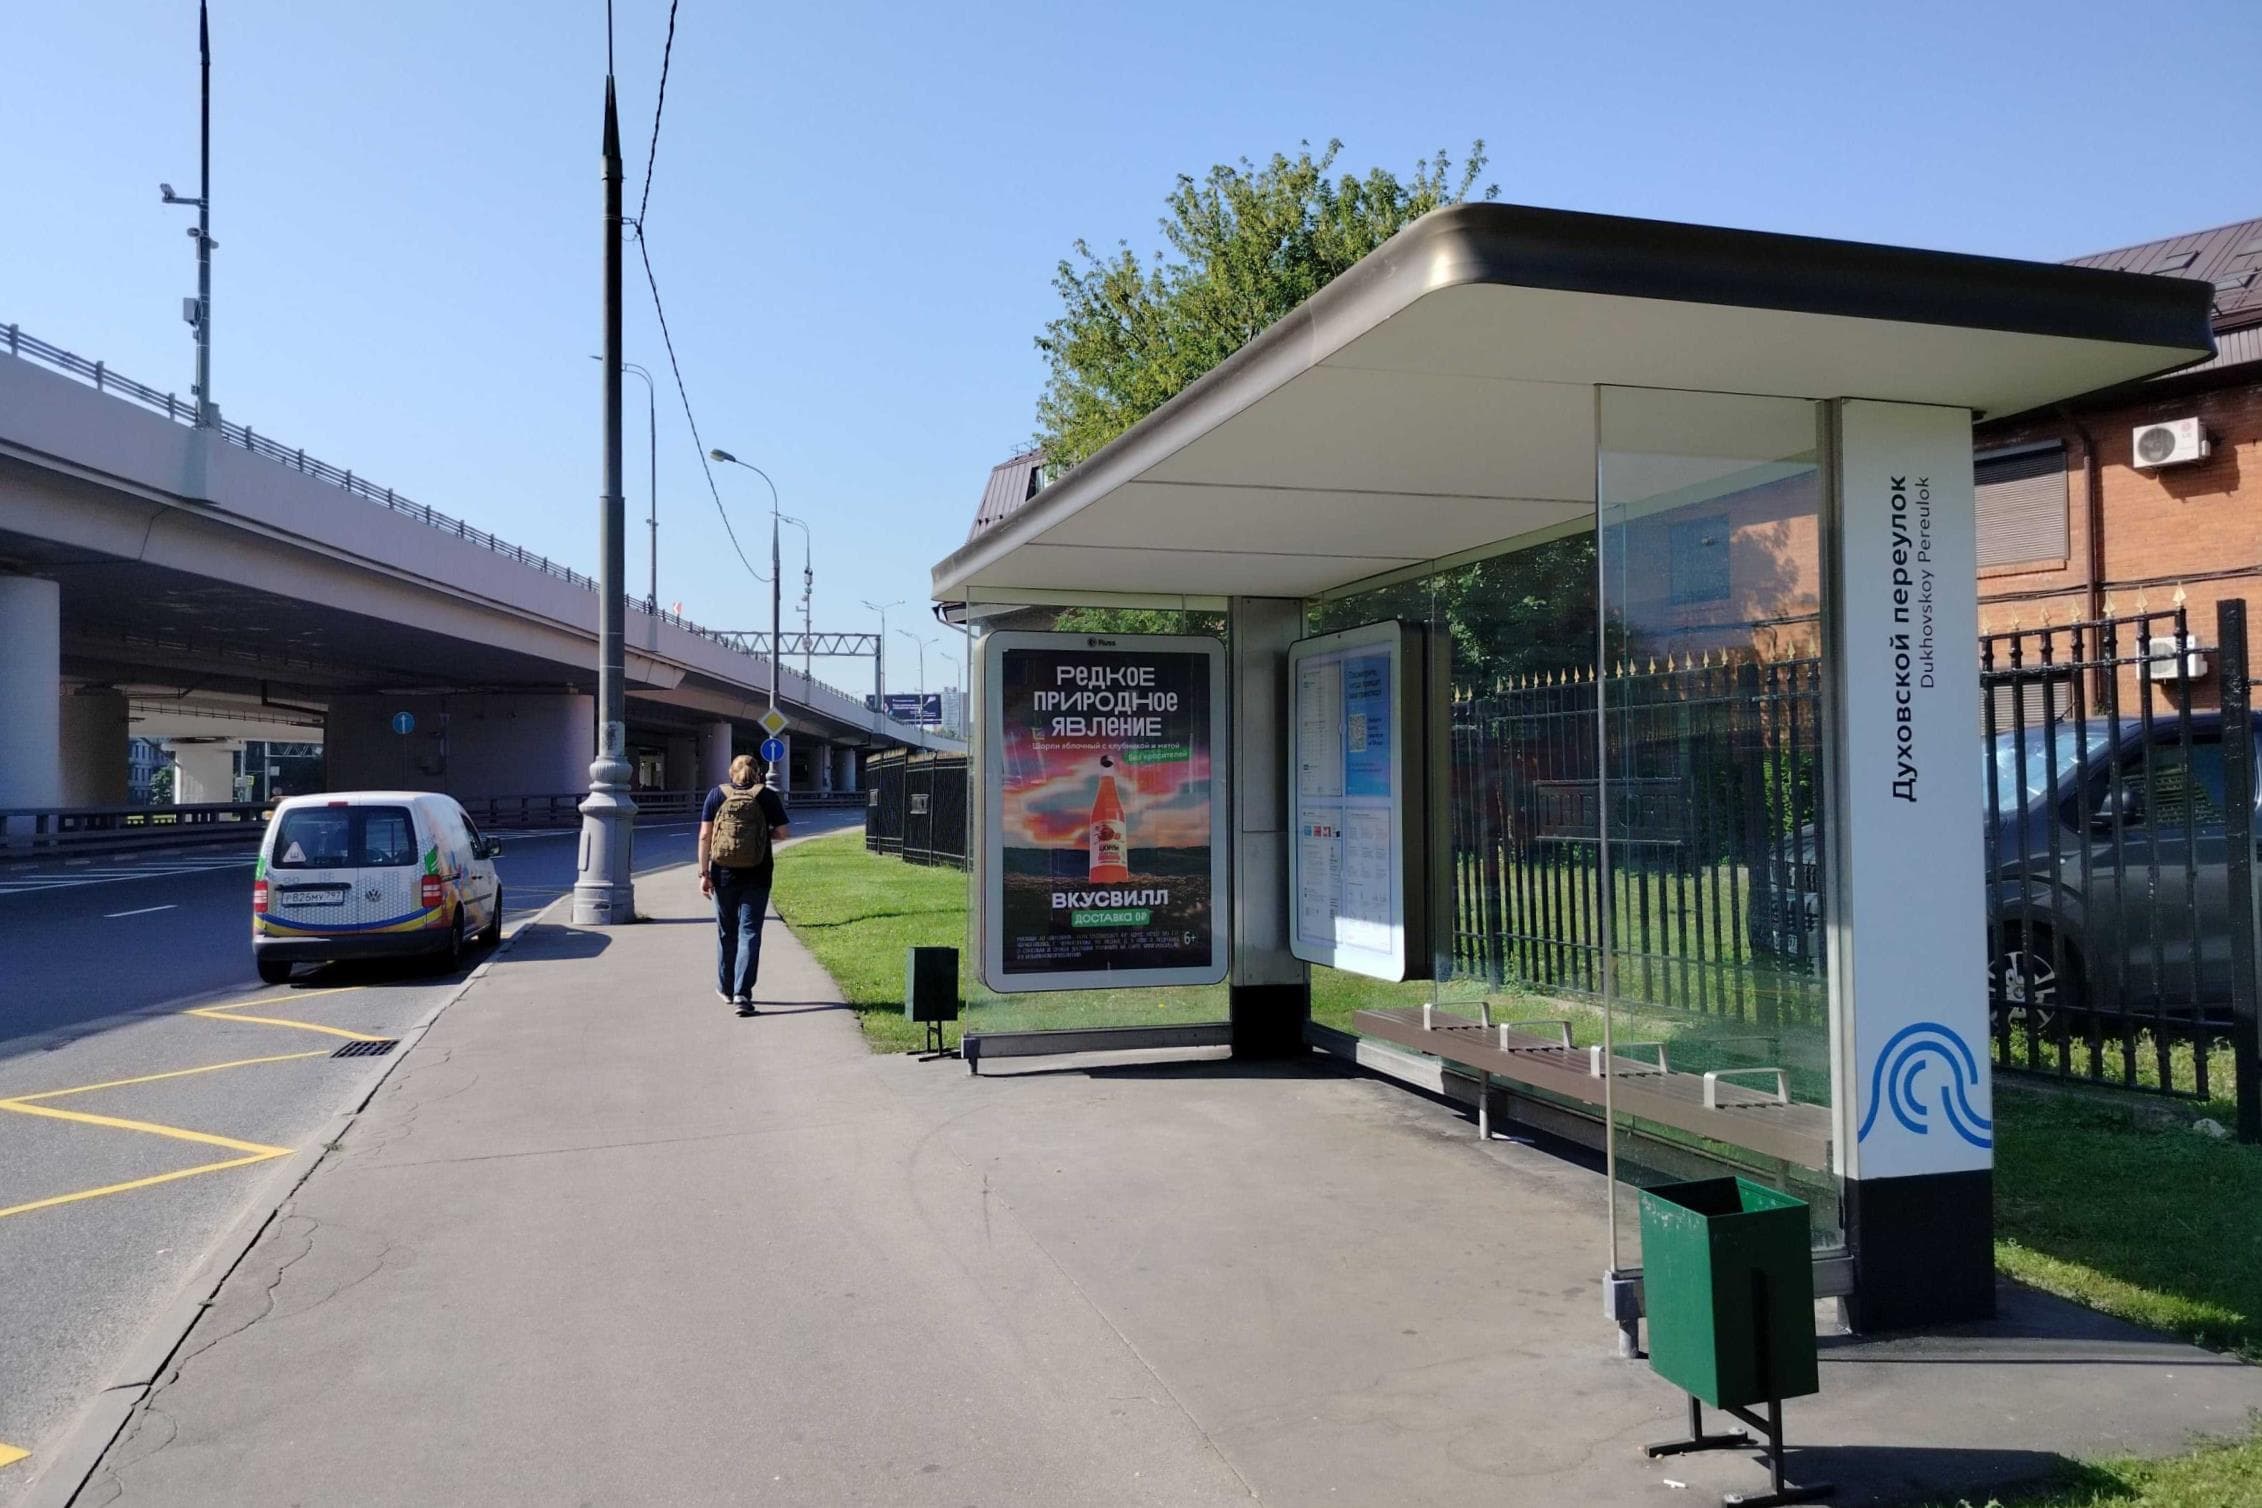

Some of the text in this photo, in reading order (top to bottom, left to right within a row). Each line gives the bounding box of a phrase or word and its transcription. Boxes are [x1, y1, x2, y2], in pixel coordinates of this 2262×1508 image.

[1889, 476, 1918, 802] Духовской переулок
[1914, 476, 1935, 688] Dukhovskoy Pereulok
[1052, 889, 1169, 908] ВКУСВИЛЛ
[1183, 931, 1197, 945] 6+
